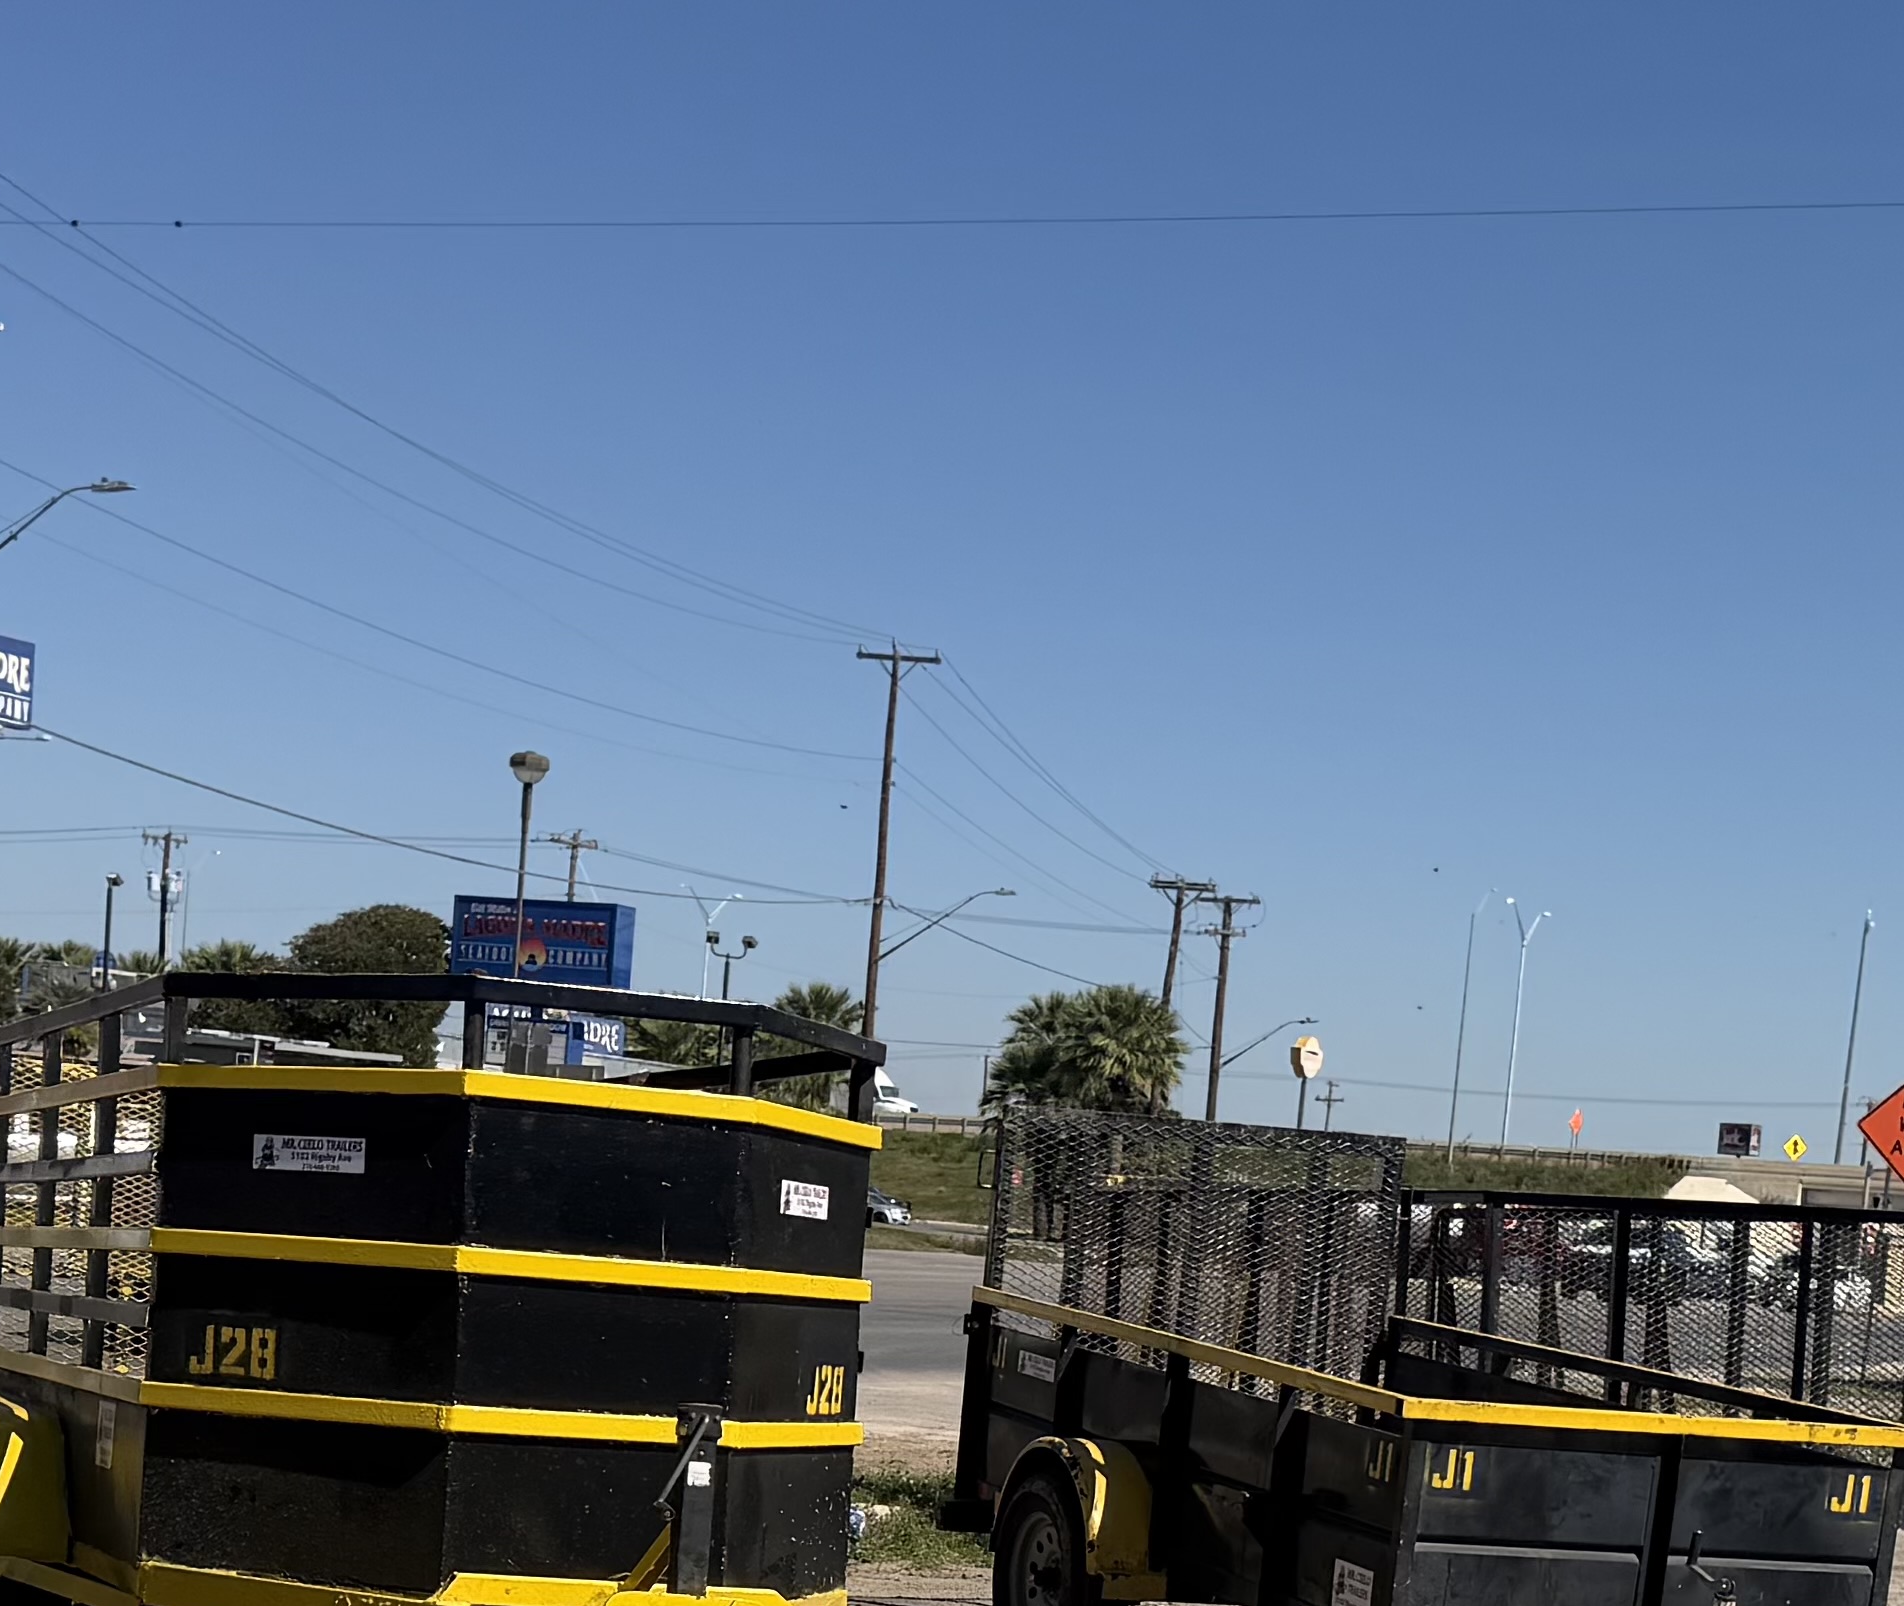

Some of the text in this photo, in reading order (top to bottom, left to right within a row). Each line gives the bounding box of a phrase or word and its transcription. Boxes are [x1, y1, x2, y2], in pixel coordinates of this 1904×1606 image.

[542, 918, 609, 947] MADRE
[547, 949, 607, 969] COMPANY
[189, 1325, 276, 1380] J28
[806, 1365, 845, 1415] J28
[1368, 1440, 1394, 1482] J1
[1431, 1448, 1474, 1491] J1
[1830, 1474, 1872, 1514] J1
